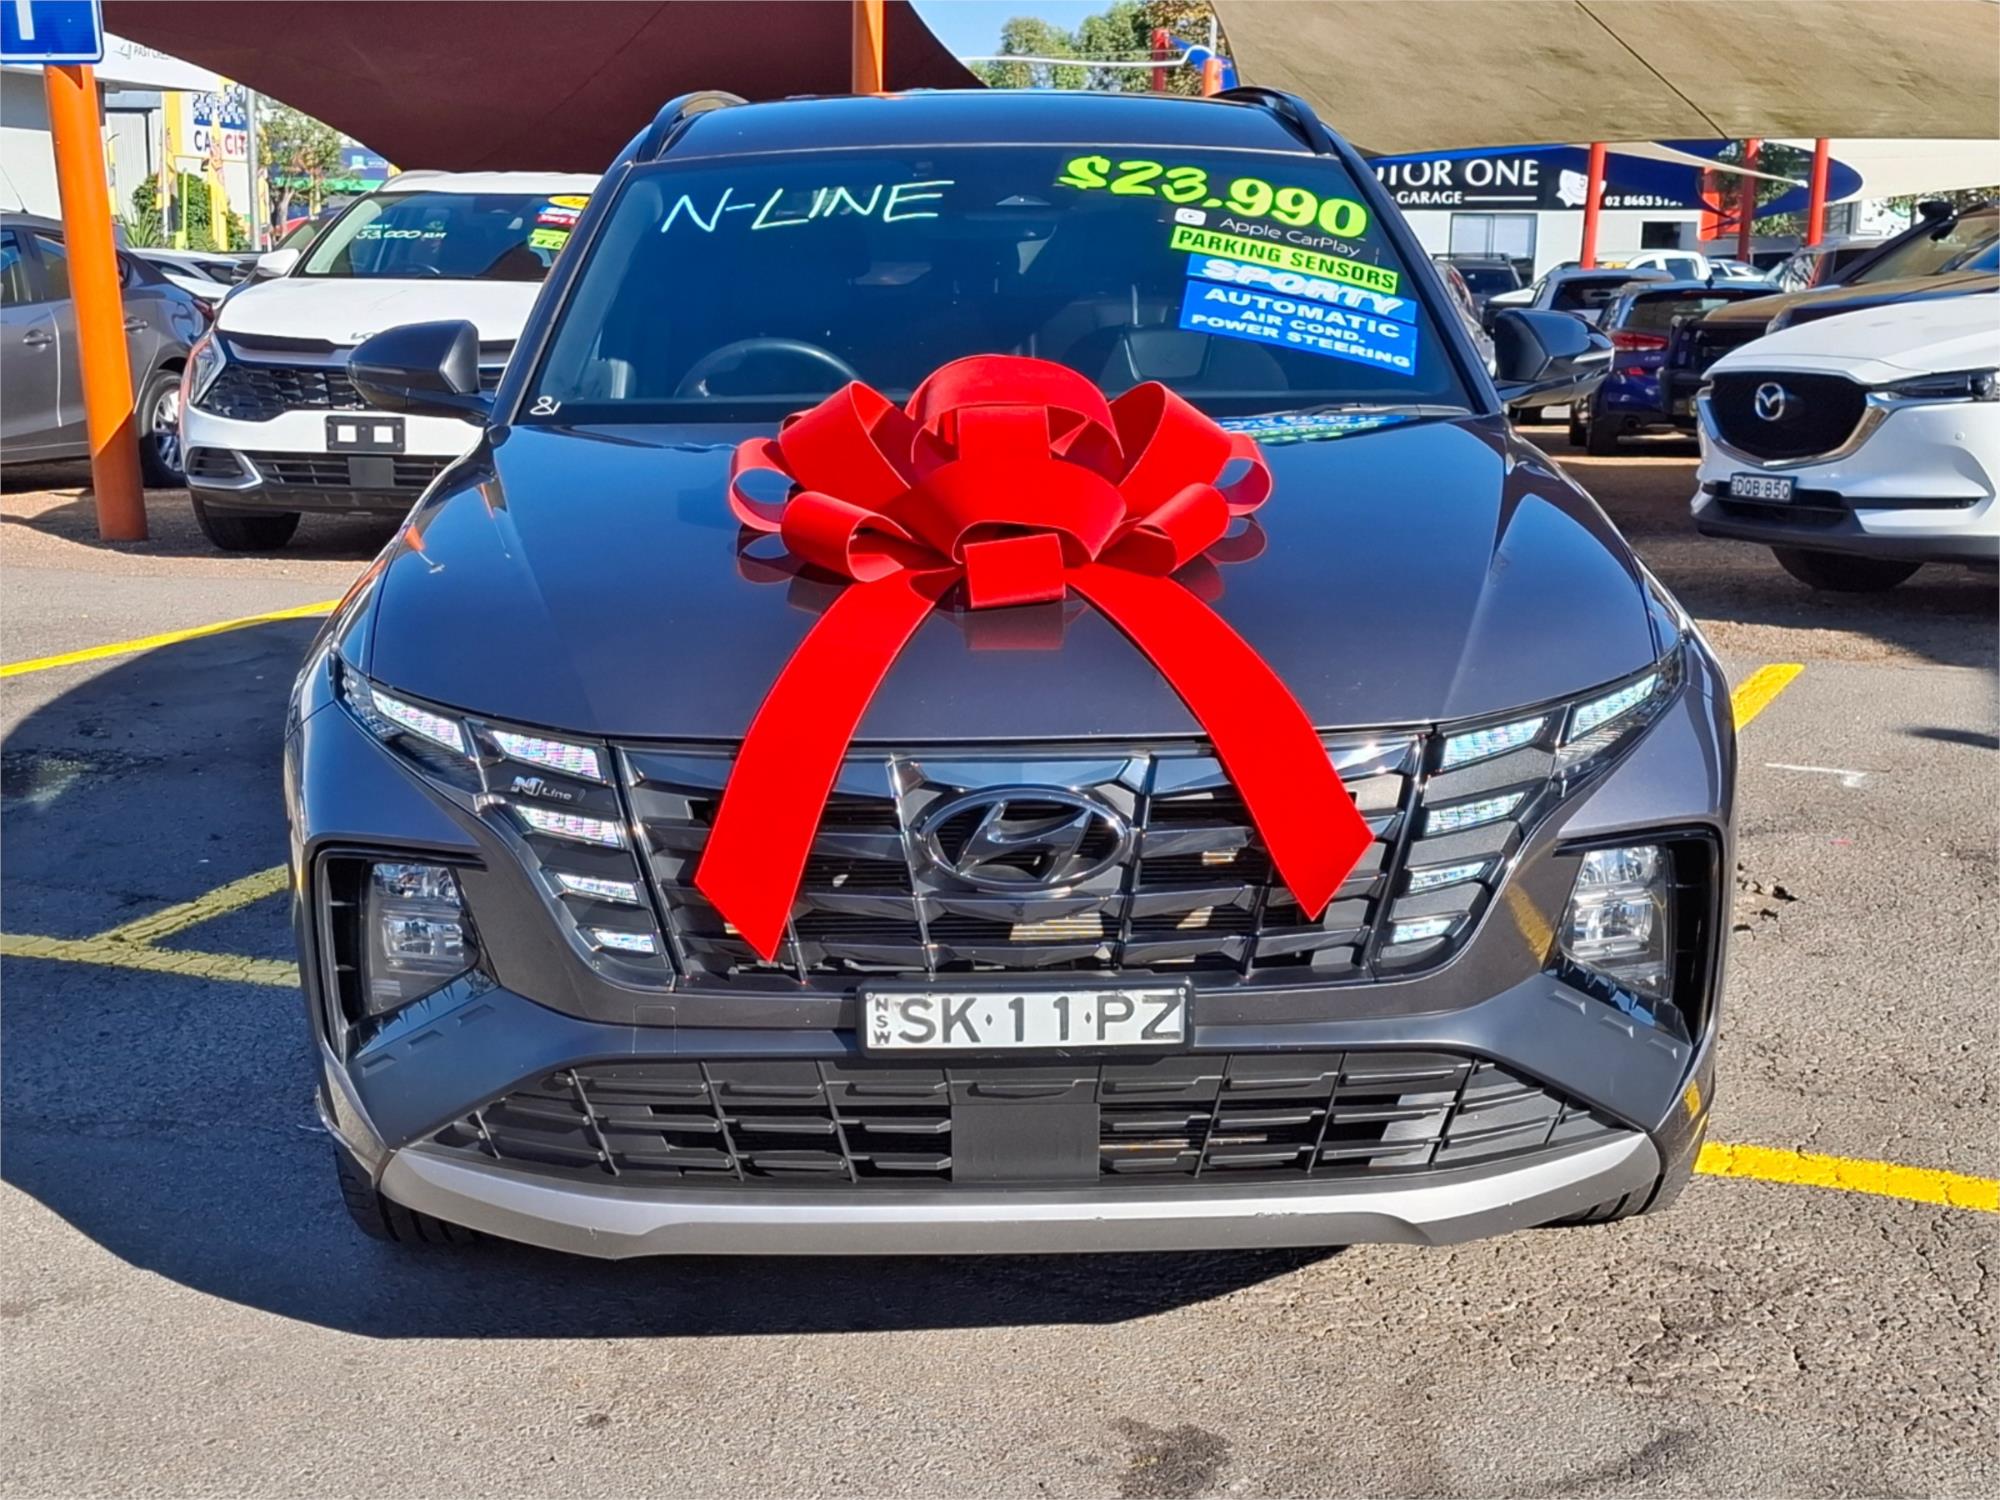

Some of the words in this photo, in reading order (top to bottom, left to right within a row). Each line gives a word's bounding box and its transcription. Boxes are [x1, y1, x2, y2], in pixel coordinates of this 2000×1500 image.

[194, 130, 211, 152] CA
[224, 133, 246, 155] CIT
[1464, 158, 1539, 187] ONE
[660, 180, 955, 233] N-LINE
[1396, 190, 1463, 205] GARAGE
[1604, 195, 1621, 207] 02
[1623, 195, 1653, 207] 8663
[1219, 217, 1282, 240] Apple
[1286, 230, 1361, 258] CarPlay
[1177, 230, 1282, 263] PARKING
[1289, 250, 1396, 289] SENSORS
[1202, 258, 1405, 316] SPORTY
[1204, 287, 1401, 338] AUTOMATIC
[1241, 309, 1283, 327] AIR
[1288, 321, 1366, 345] COND.
[1190, 313, 1281, 339] POWER
[1286, 330, 1411, 369] STEERING
[542, 787, 573, 801] Line
